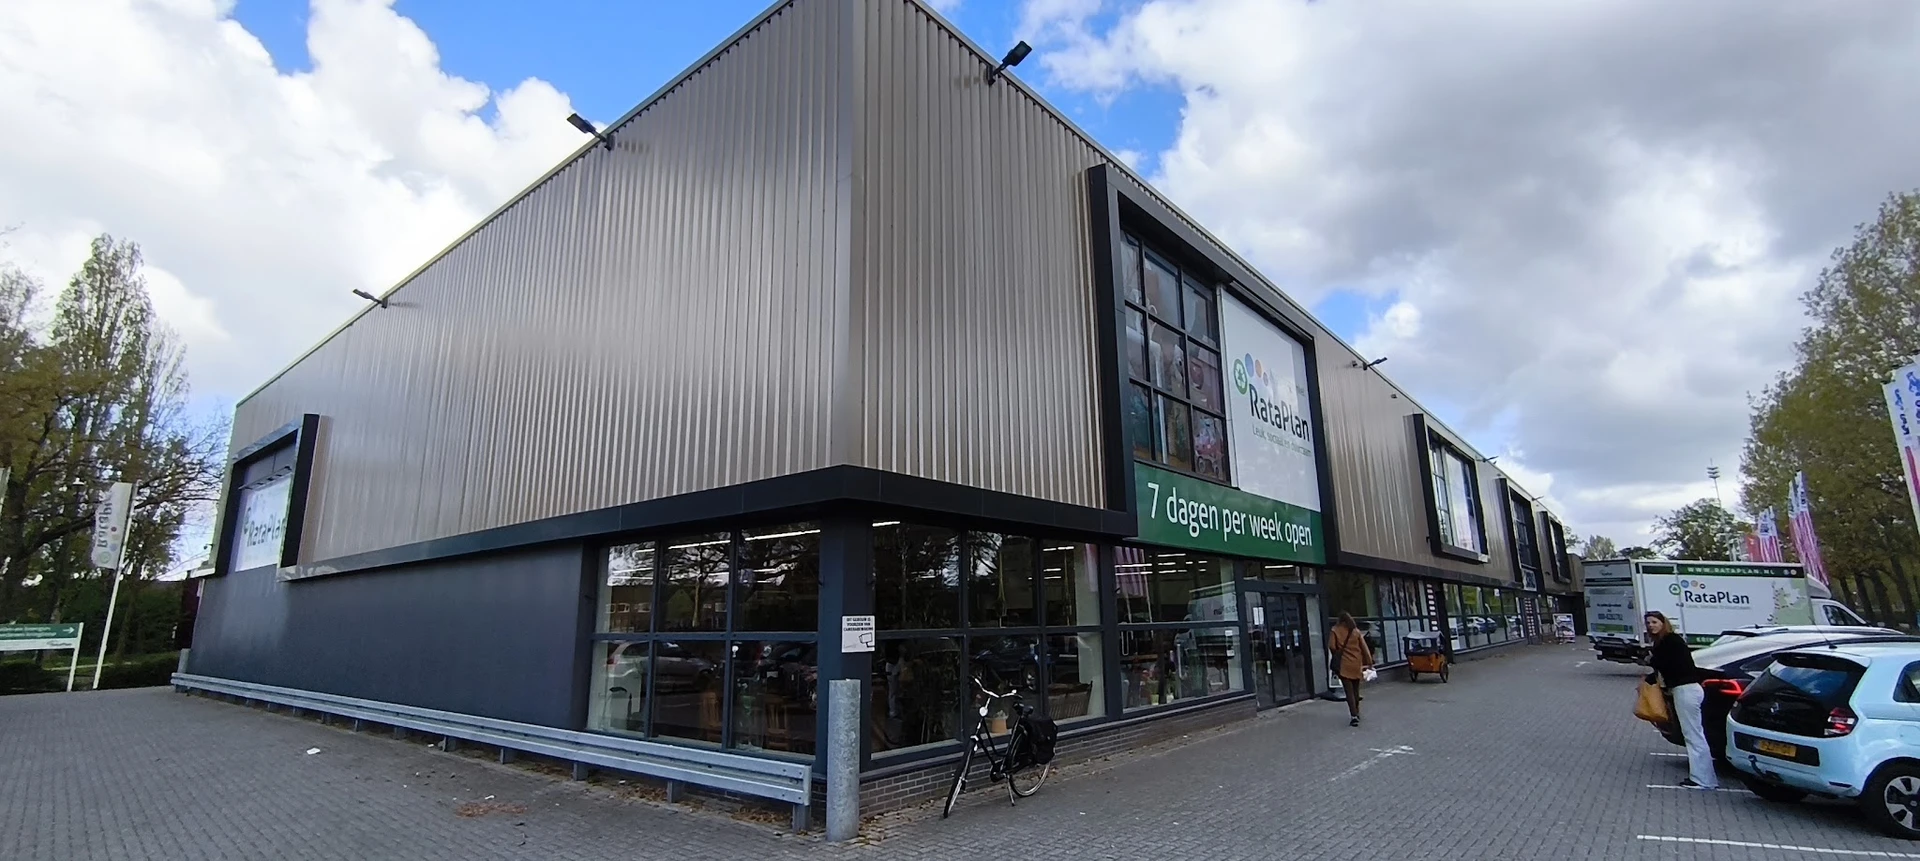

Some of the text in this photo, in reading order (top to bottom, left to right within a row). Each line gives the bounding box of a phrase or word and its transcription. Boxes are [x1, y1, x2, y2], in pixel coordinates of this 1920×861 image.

[1248, 383, 1310, 442] RataPlan
[1147, 482, 1313, 552] 7 dagen per week open
[1687, 567, 1775, 575] WWW.RATAPLAN.NL
[1684, 590, 1750, 604] RataPlan
